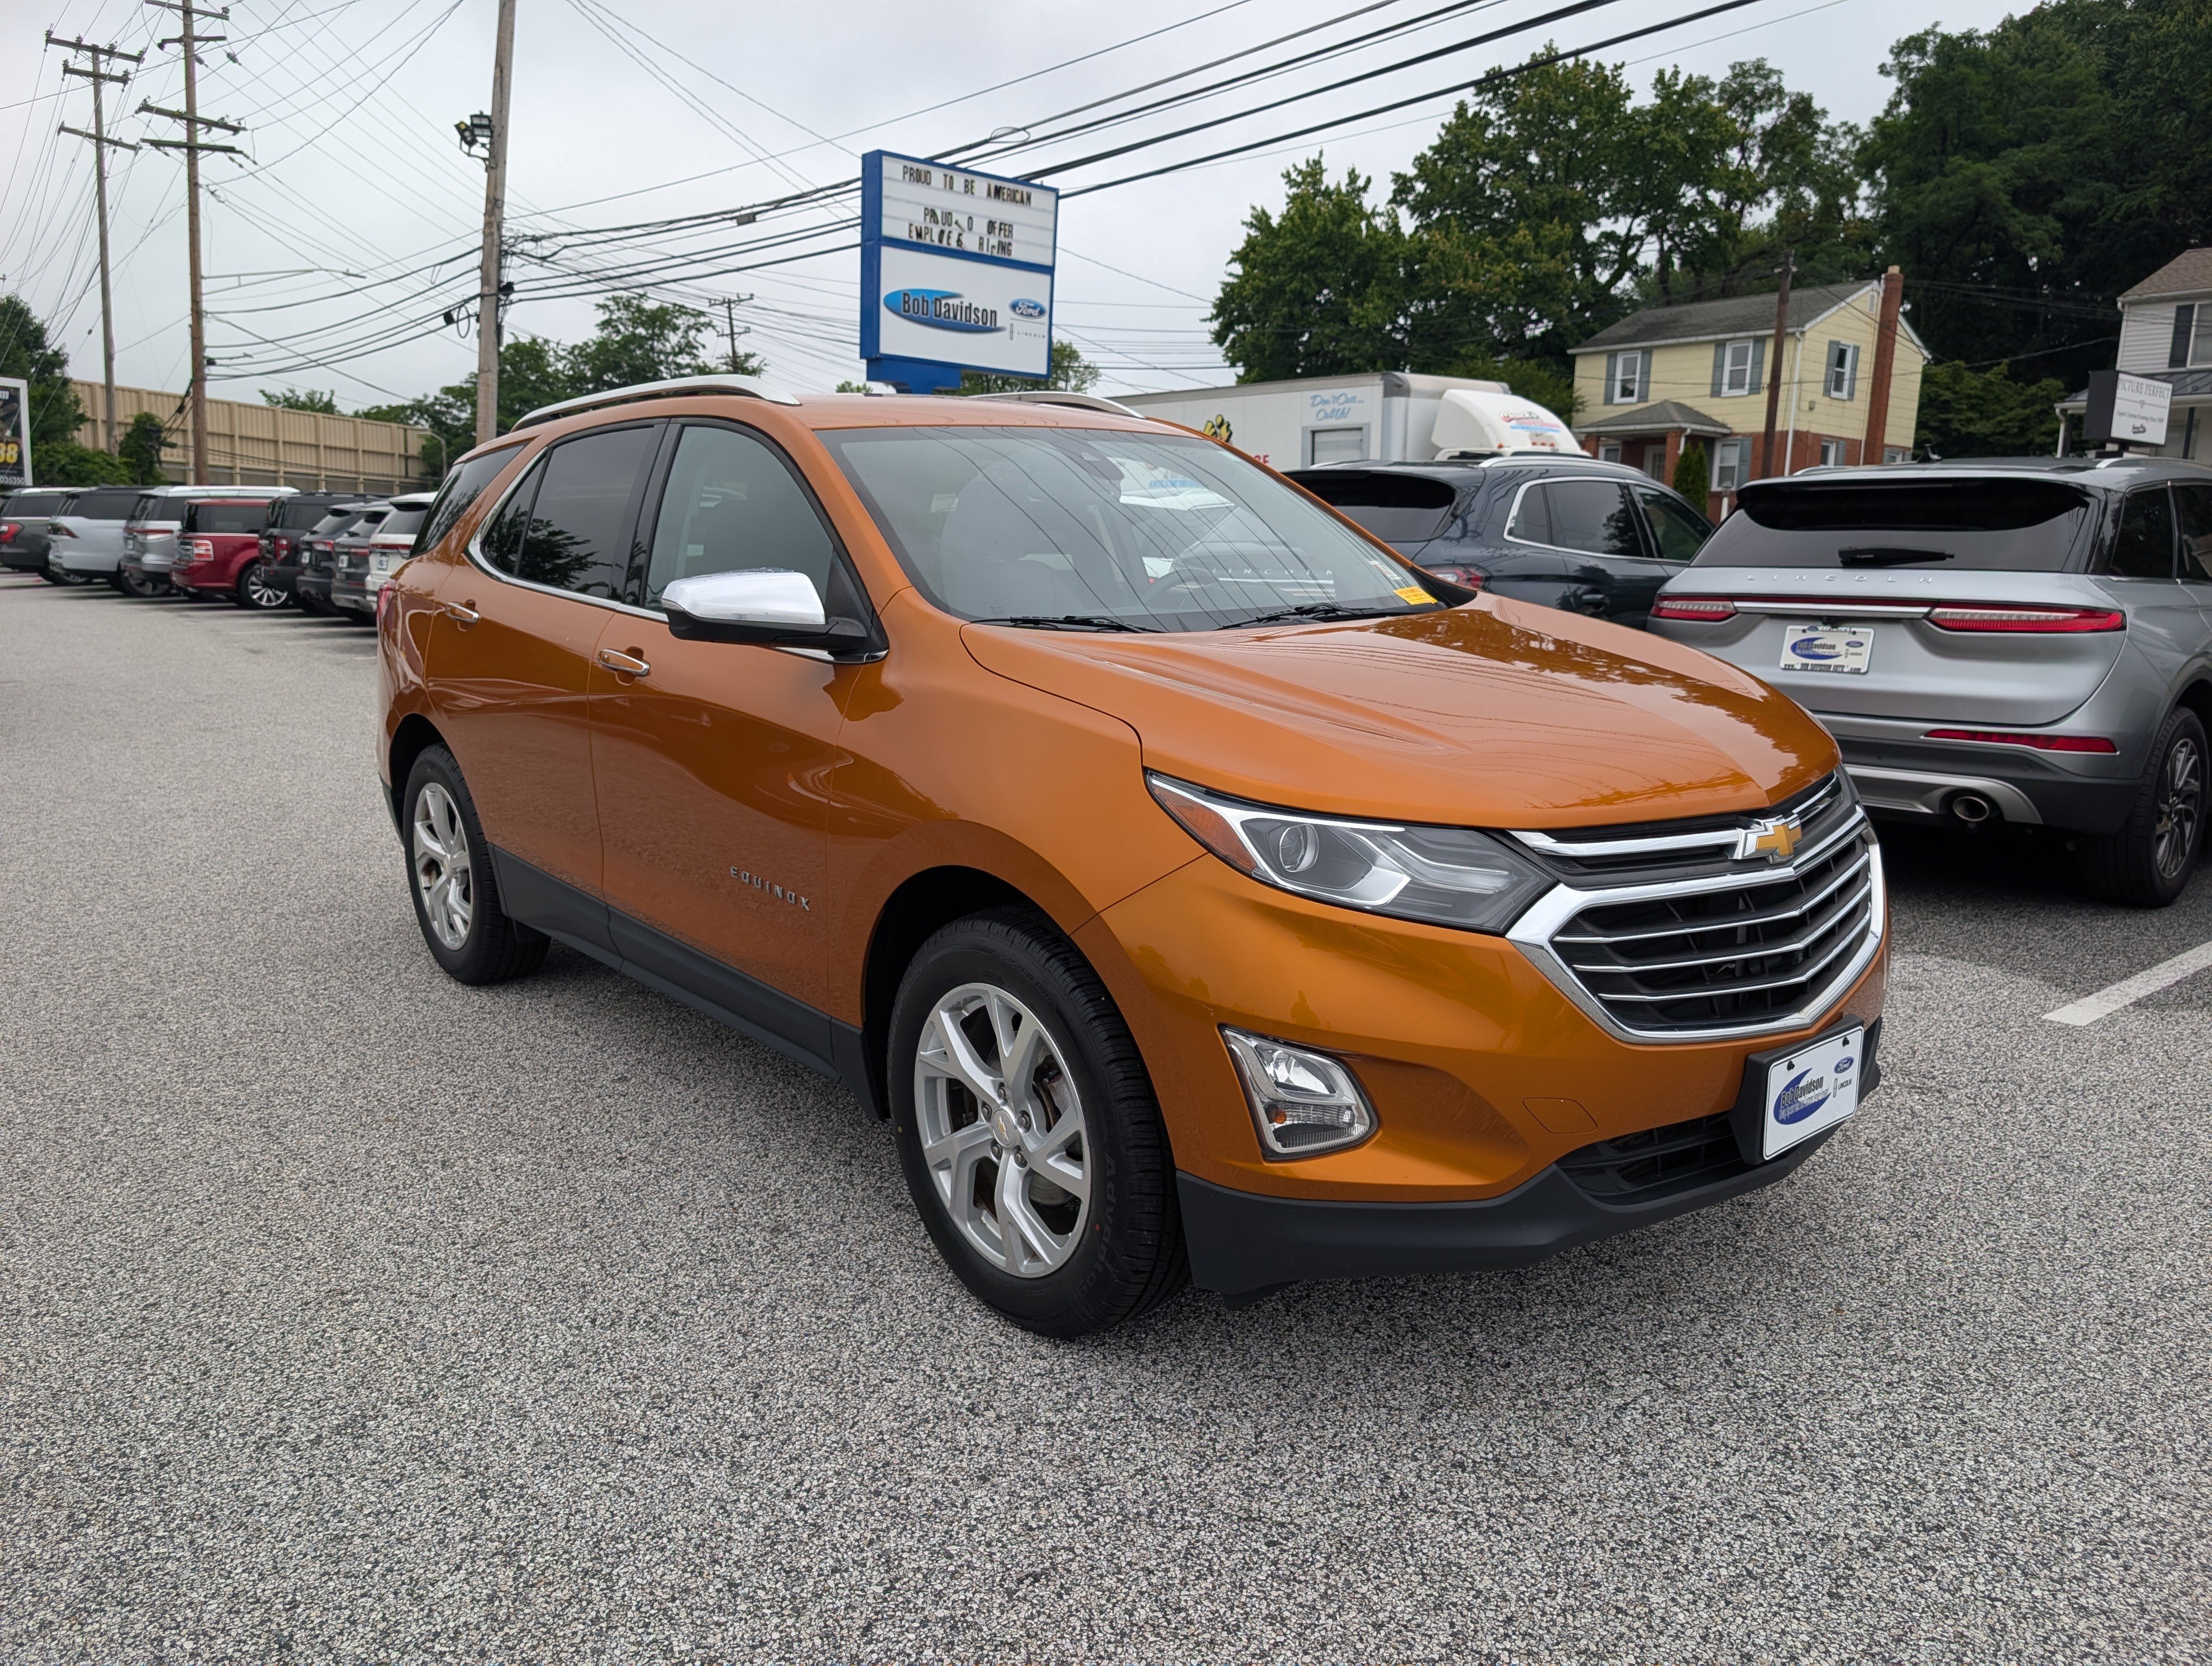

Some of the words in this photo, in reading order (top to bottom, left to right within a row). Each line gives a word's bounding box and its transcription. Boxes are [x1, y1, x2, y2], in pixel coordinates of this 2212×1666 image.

[902, 165, 932, 185] PROUD
[943, 173, 954, 190] TO
[964, 178, 975, 195] BE
[986, 182, 1032, 207] AMERICAN
[987, 220, 1014, 239] OFFER
[903, 292, 929, 316] Bob
[934, 297, 998, 328] Davidson
[1015, 300, 1043, 317] Ford
[2117, 378, 2144, 395] PICTURE
[2145, 383, 2170, 400] PERFECT
[1747, 574, 1934, 584] LINCOLN
[730, 866, 810, 912] EQUINOX
[1836, 1058, 1852, 1072] Ford
[1782, 1087, 1795, 1107] Bob
[1795, 1075, 1824, 1100] Davidson
[1838, 1078, 1852, 1090] LINCOLN
